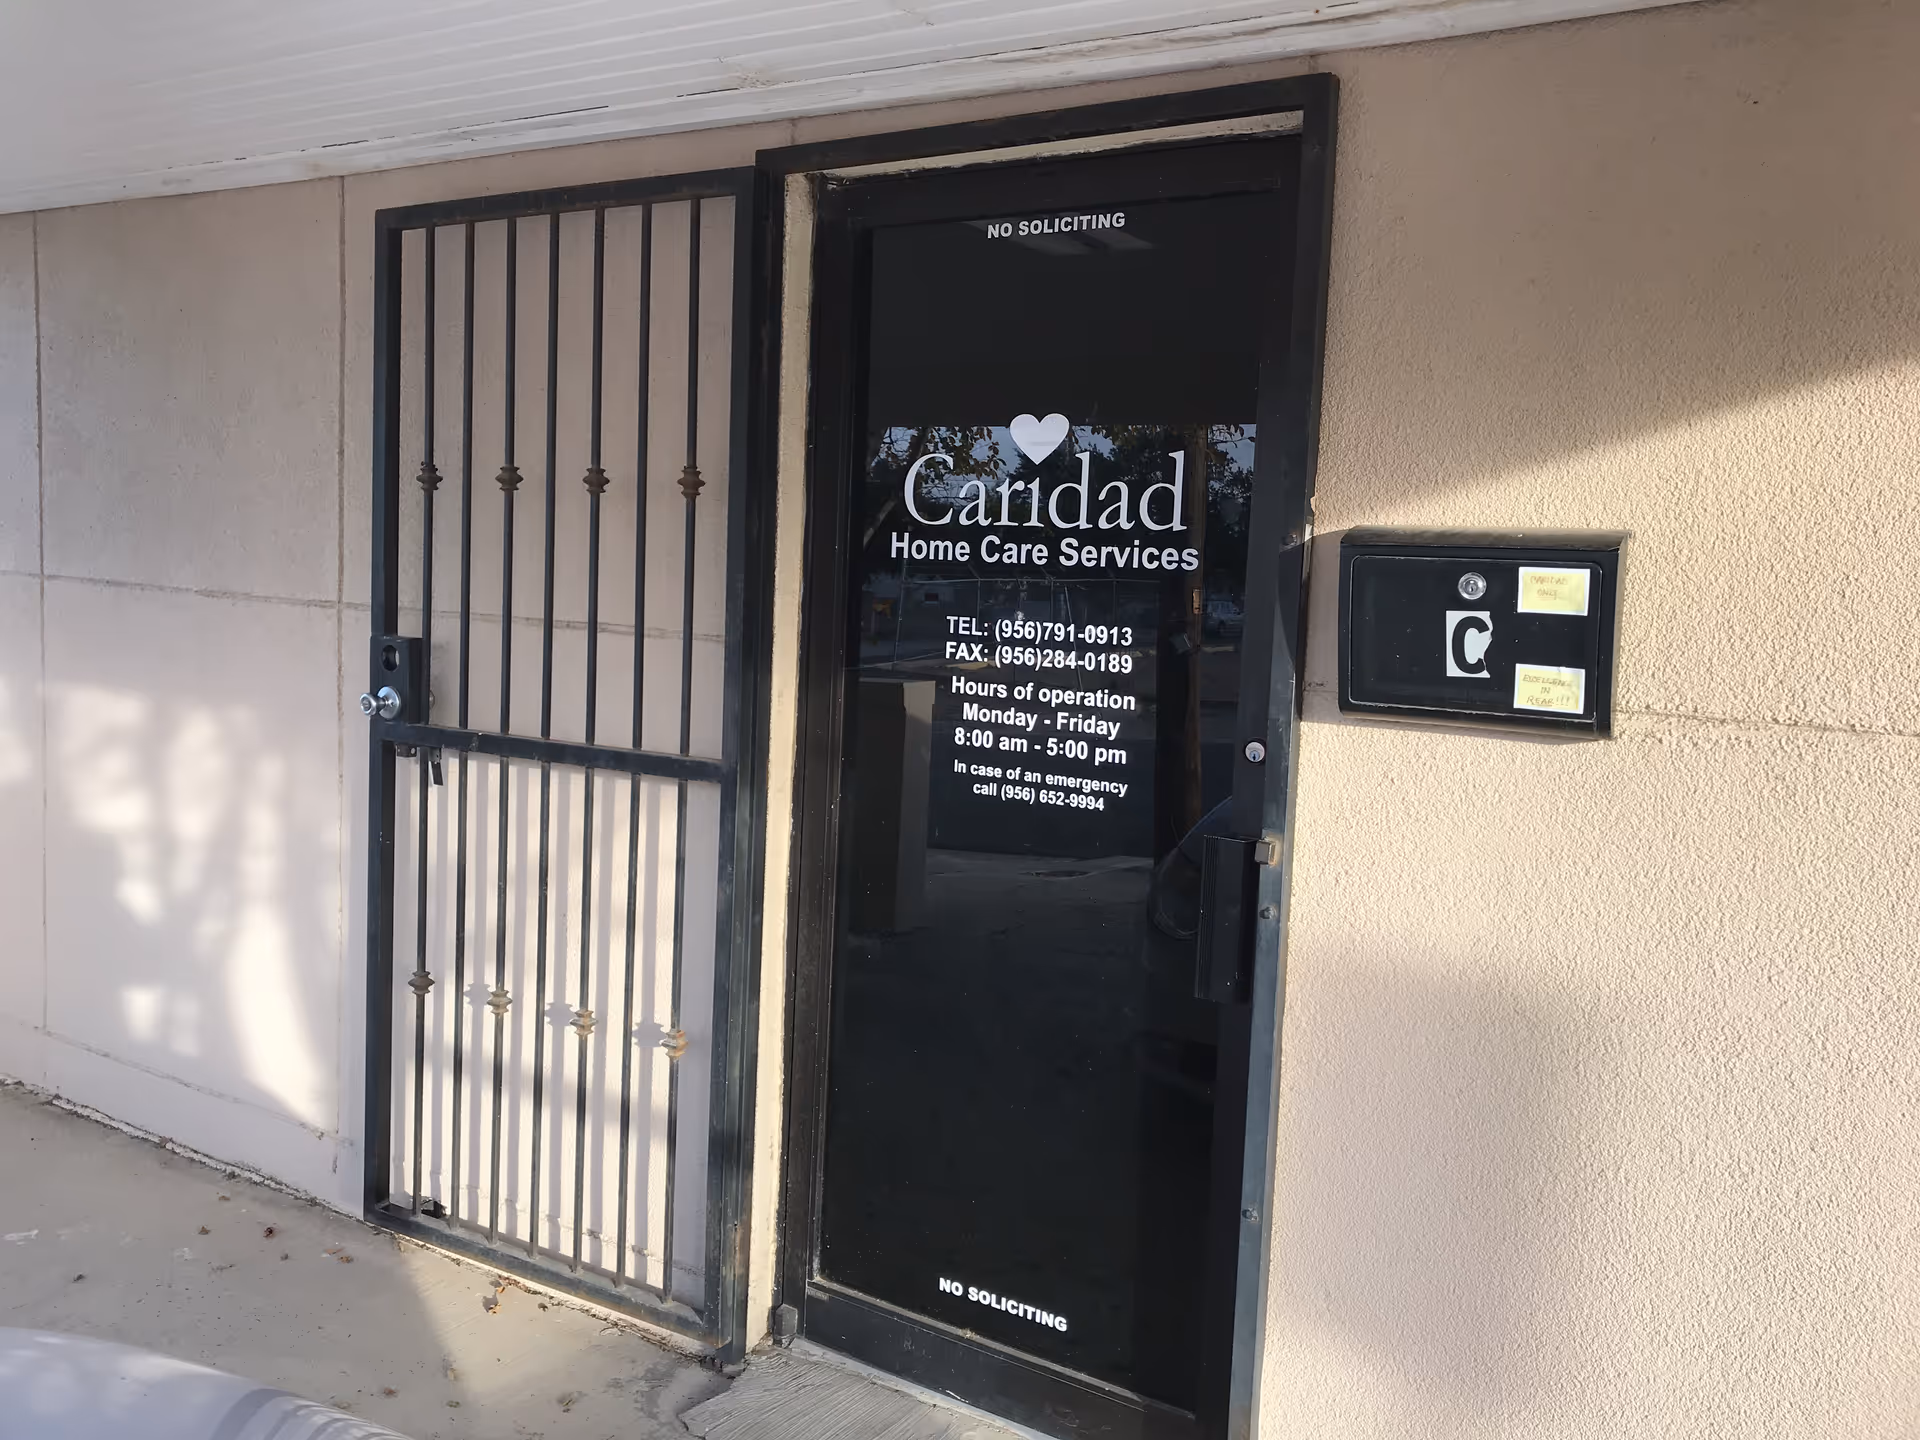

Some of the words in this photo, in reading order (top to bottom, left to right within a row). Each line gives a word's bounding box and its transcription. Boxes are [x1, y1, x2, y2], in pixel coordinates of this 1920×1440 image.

[987, 222, 1013, 239] NO
[1018, 212, 1126, 236] SOLICITING
[903, 450, 1188, 532] Caridad
[890, 531, 971, 563] Home
[980, 534, 1049, 566] Care
[1058, 537, 1200, 572] Services
[946, 615, 989, 637] TEL:
[995, 618, 1133, 647] (956)791-0913
[1451, 615, 1491, 675] C
[945, 641, 989, 662] FAX:
[995, 644, 1133, 674] (956)284-0189
[951, 675, 1008, 699] Hours
[1013, 682, 1035, 701] of
[1038, 687, 1137, 711] operation
[962, 702, 1038, 732] Monday
[1056, 711, 1121, 741] Friday
[954, 726, 994, 749] 8:00
[998, 736, 1028, 753] am
[1046, 737, 1089, 760] 5:00
[1094, 745, 1127, 766] pm
[953, 759, 967, 774] In
[970, 762, 1003, 778] case
[1005, 766, 1022, 781] of
[1023, 769, 1042, 784] an
[1045, 772, 1129, 798] emergency
[972, 781, 998, 797] call
[1000, 783, 1036, 805] (956)
[1039, 789, 1105, 812] 652-9994
[938, 1276, 964, 1298] NO
[967, 1286, 1068, 1332] SOLICITING
